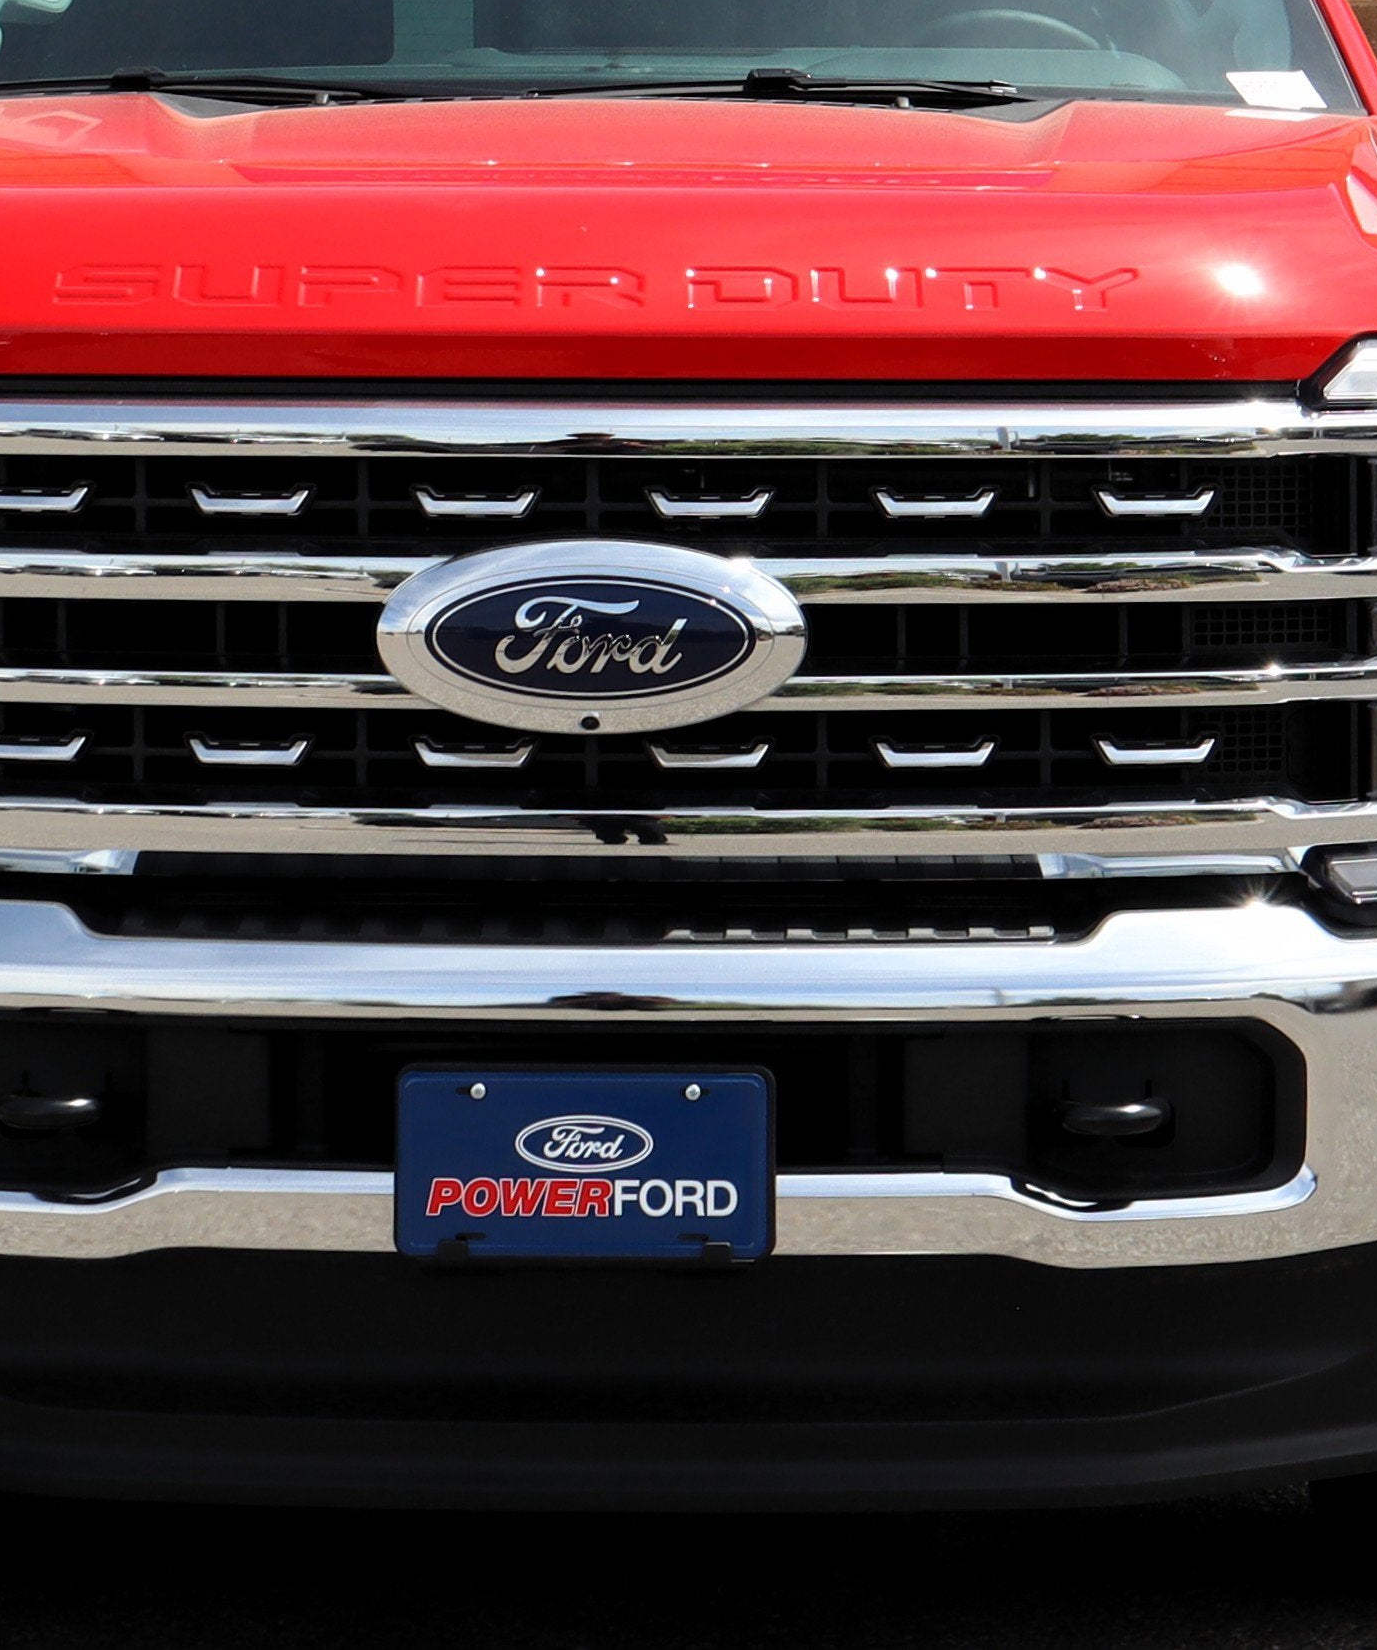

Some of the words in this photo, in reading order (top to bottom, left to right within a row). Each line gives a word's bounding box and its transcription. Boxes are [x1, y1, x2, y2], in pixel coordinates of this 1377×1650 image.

[52, 264, 644, 309] SUPER
[685, 266, 1139, 310] DUTY
[494, 595, 688, 675] Ford
[544, 1125, 625, 1159] Ford
